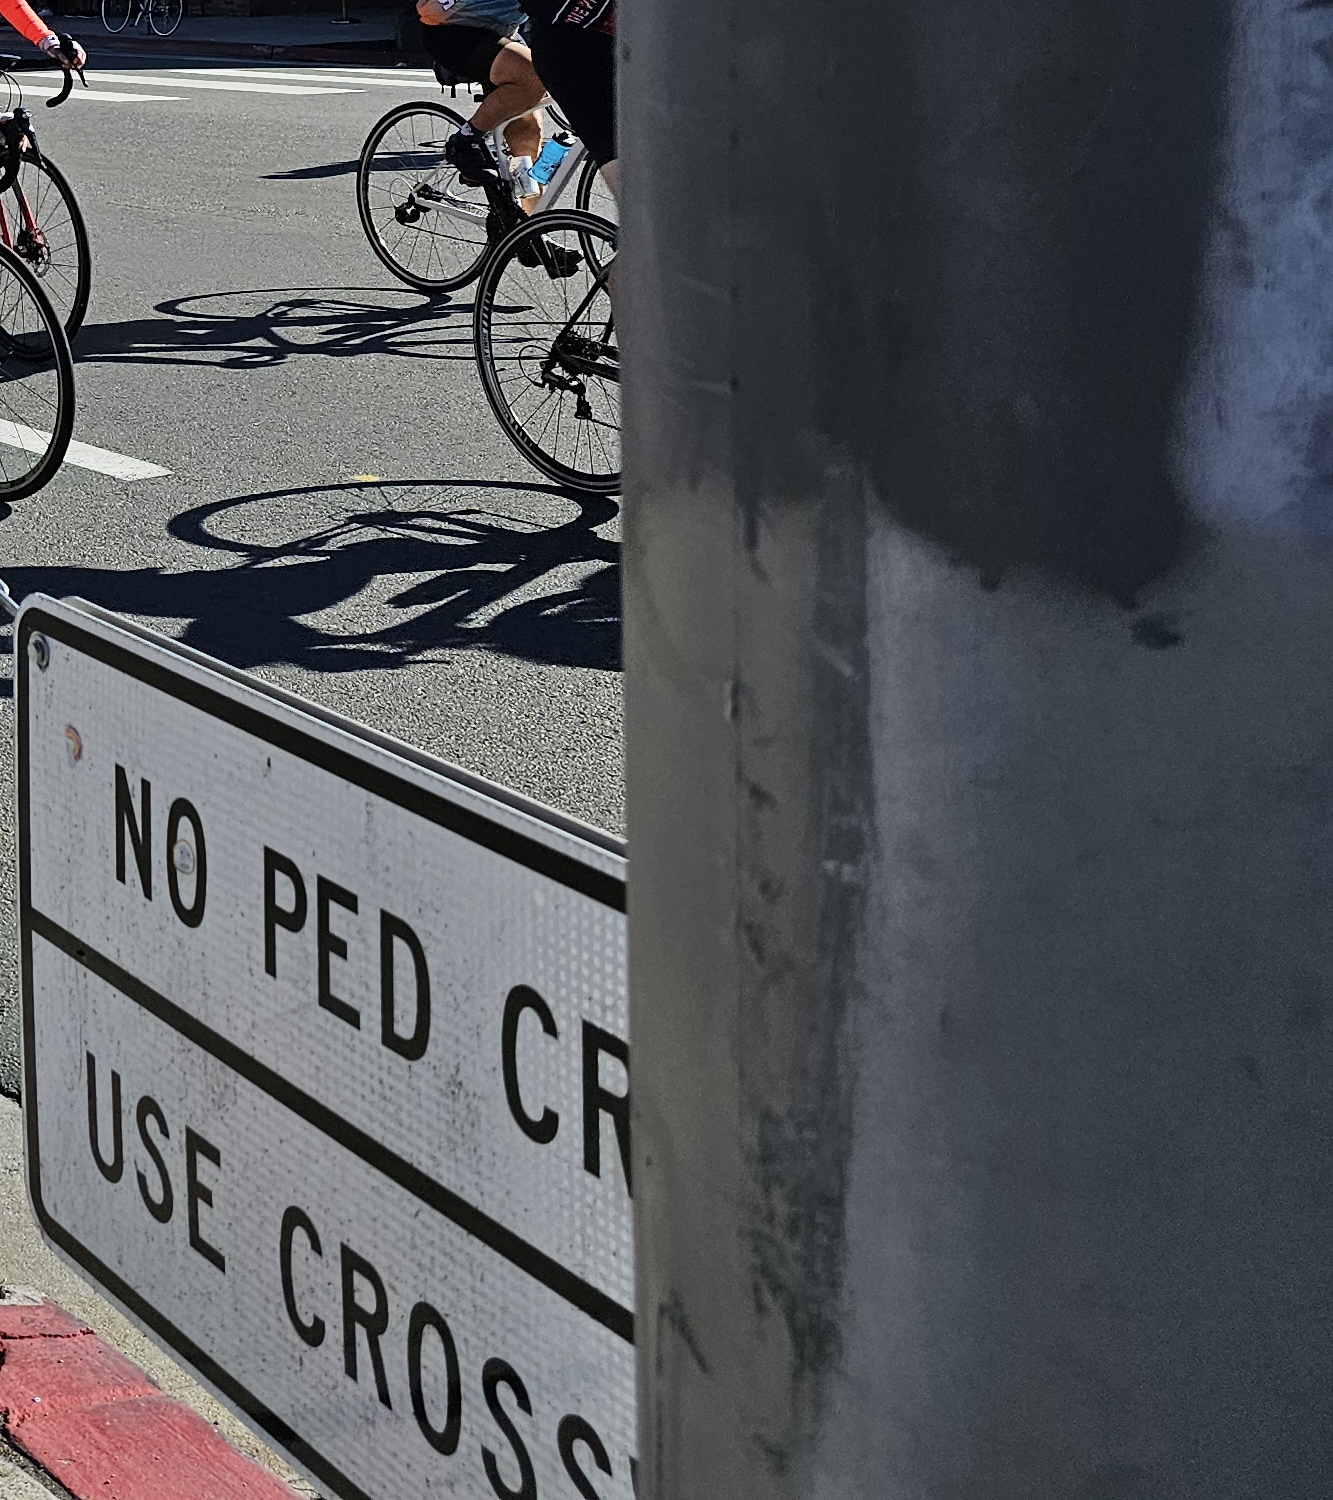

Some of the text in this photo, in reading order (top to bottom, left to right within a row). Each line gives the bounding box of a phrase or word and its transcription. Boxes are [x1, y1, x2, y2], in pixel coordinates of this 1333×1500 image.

[114, 762, 632, 1199] NO PED CR
[86, 1050, 627, 1500] USE CROSS
